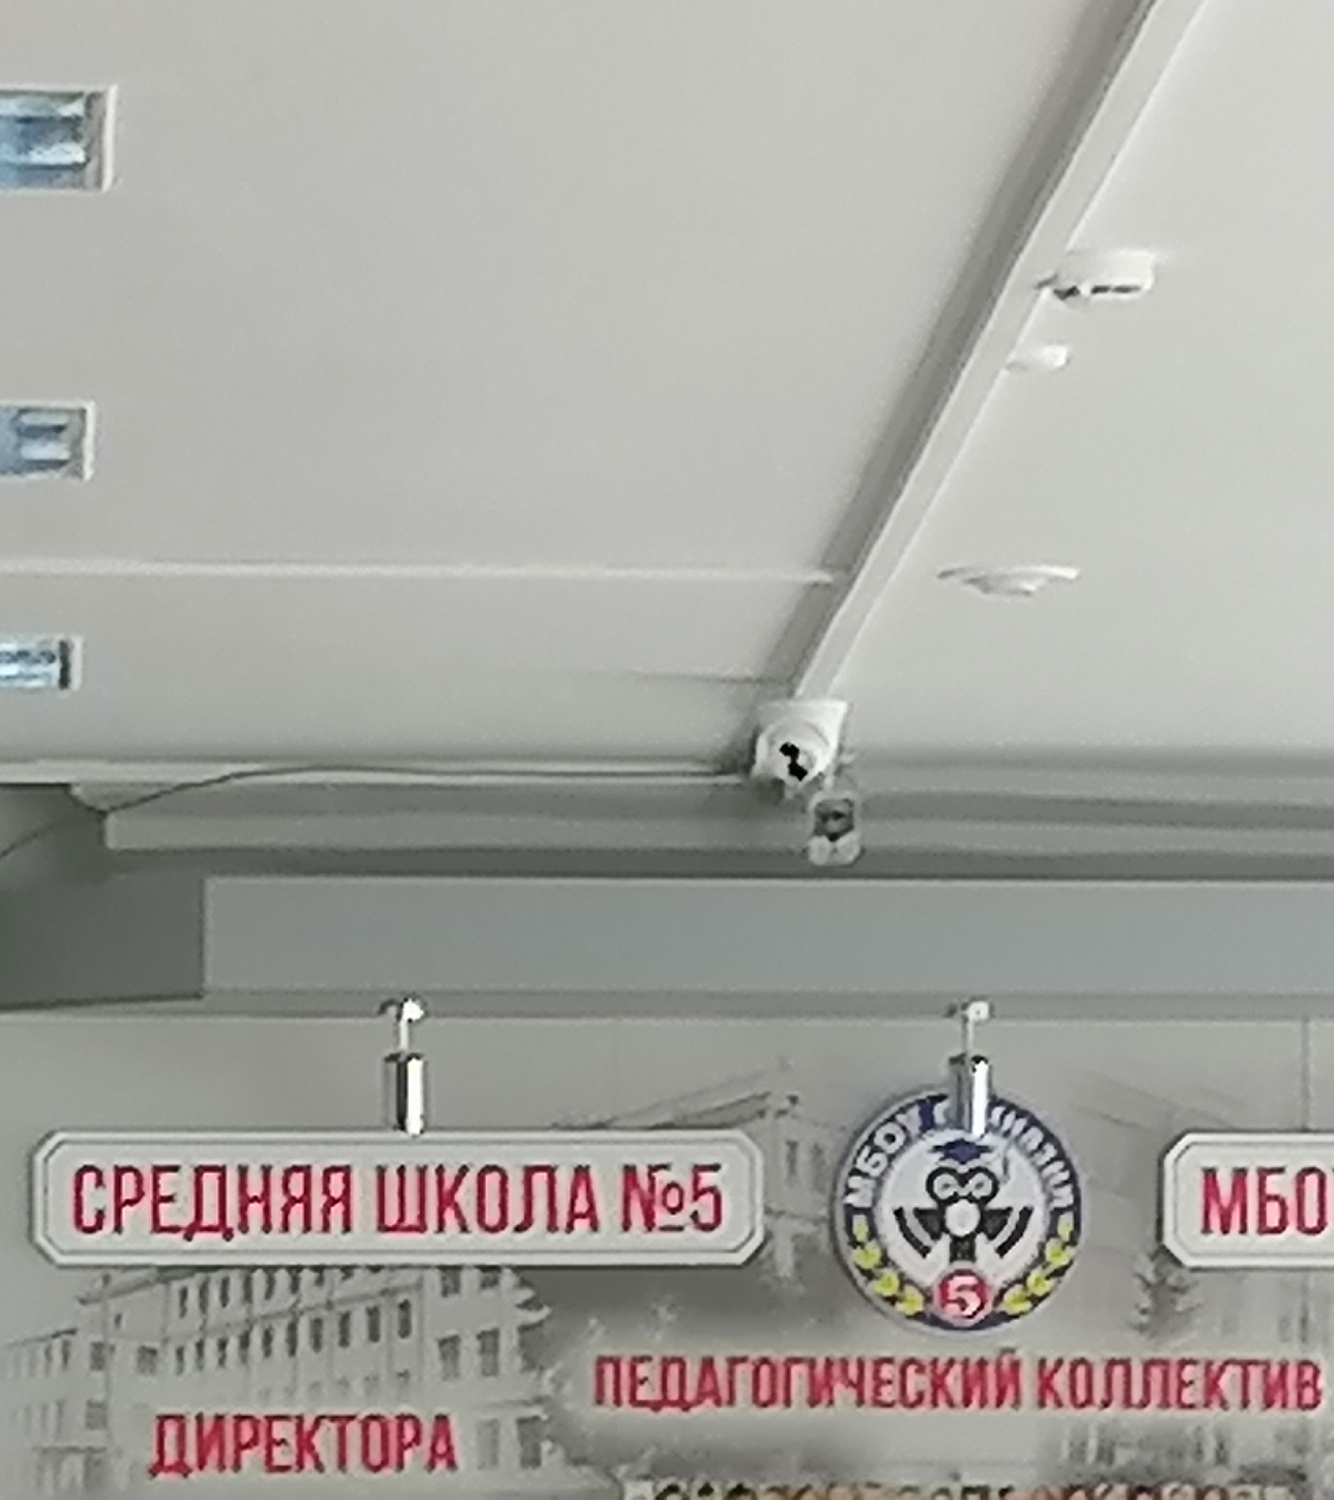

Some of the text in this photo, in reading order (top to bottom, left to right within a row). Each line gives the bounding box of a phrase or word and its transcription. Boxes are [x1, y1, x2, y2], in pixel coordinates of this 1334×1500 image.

[72, 1164, 724, 1241] СРЕДНЯЯ ШКОЛА №5
[940, 1273, 987, 1318] 5
[593, 1349, 1323, 1414] ПЕДАГОГИЧЕСКИЙ КОЛЛЕКТИВ
[148, 1412, 459, 1480] ДИРЕКТОРА
